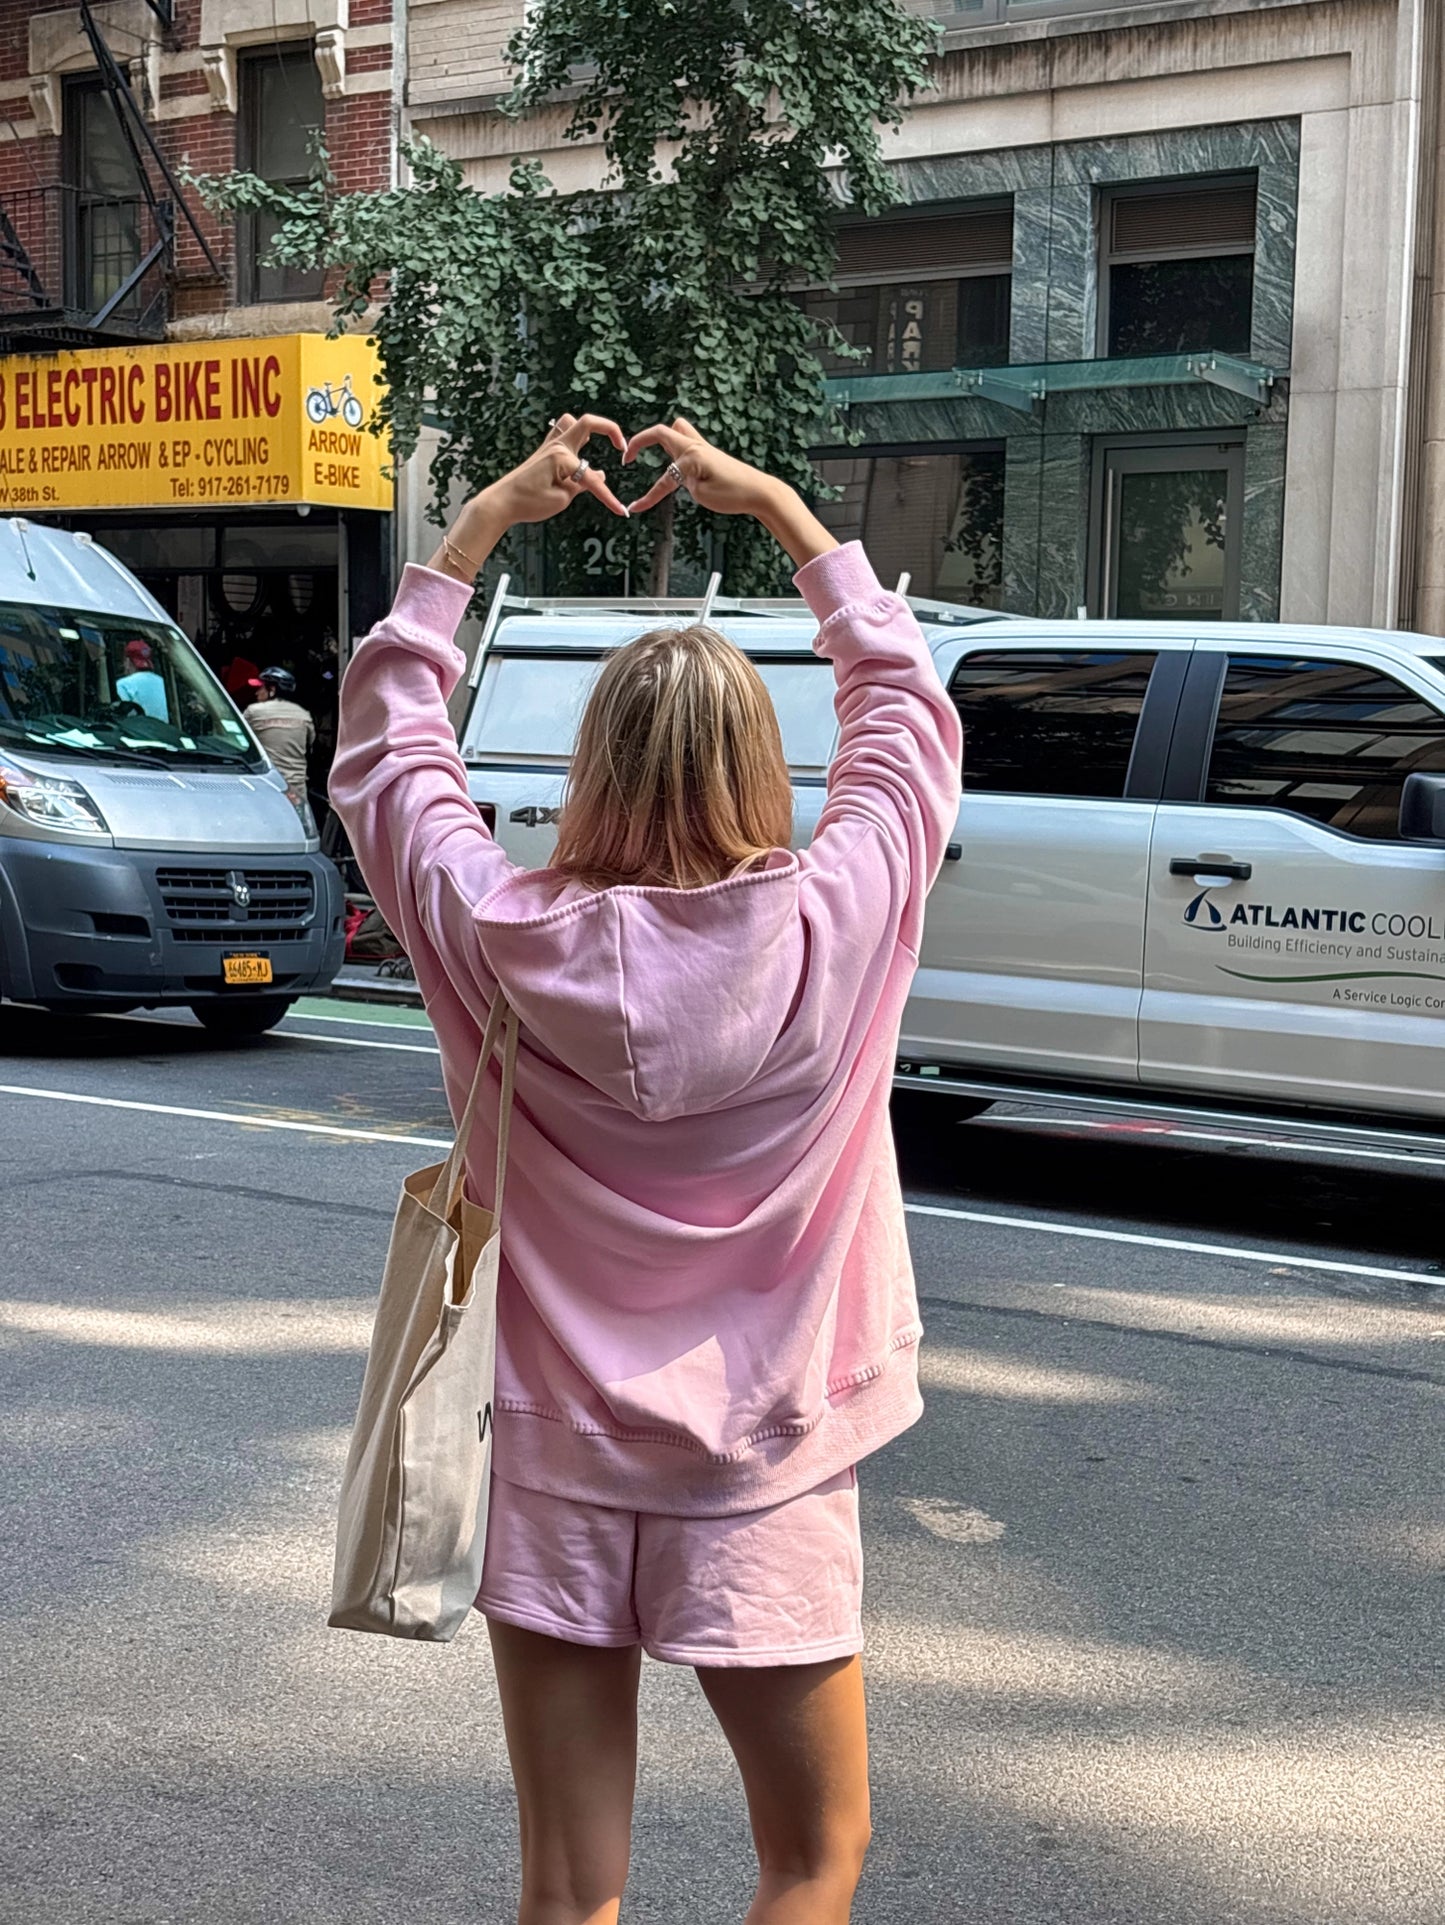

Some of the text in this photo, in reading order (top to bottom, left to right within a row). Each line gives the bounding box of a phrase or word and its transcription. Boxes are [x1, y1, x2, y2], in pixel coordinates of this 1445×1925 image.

[15, 363, 146, 429] ELECTRIC
[155, 360, 221, 422] BIKE
[231, 355, 282, 418] INC
[28, 447, 37, 473] &
[42, 444, 91, 473] REPAIR
[97, 441, 150, 470] ARROW
[159, 441, 169, 468] &
[173, 441, 191, 467] EP
[203, 437, 269, 467] CYCLING
[308, 429, 361, 457] ARROW
[170, 475, 289, 497] Tel: 917-261-7179
[314, 462, 361, 489] E-BIKE
[11, 486, 39, 502] 38th
[42, 485, 60, 501] St.
[1229, 903, 1366, 933] ATLANTIC
[1228, 934, 1281, 953] Building
[1285, 938, 1353, 959] Efficiency
[1356, 945, 1382, 959] and
[1332, 988, 1341, 1000] A
[1344, 989, 1387, 1004] Service
[1390, 992, 1421, 1008] Logic
